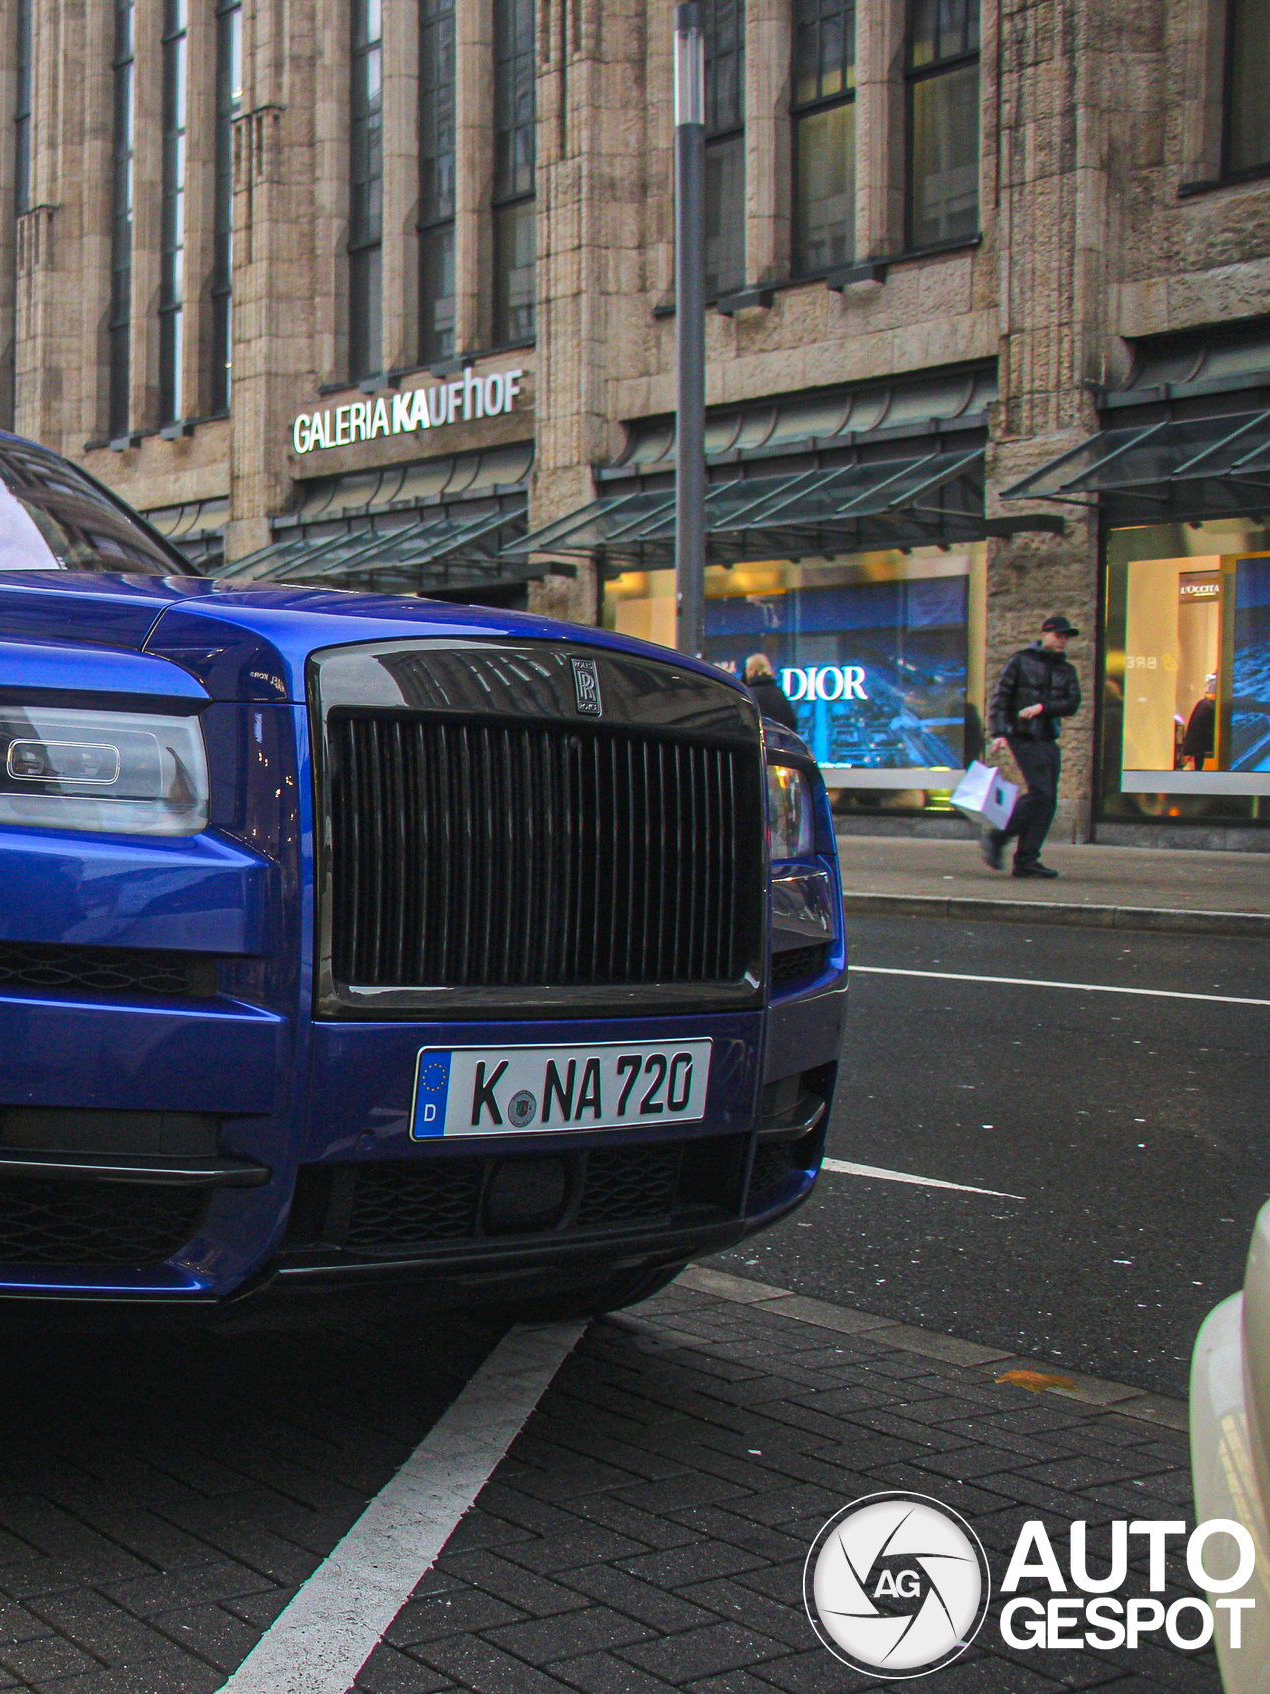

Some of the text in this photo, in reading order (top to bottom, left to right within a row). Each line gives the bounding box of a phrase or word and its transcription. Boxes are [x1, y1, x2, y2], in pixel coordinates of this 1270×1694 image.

[293, 397, 390, 454] GALERIA
[779, 665, 869, 701] DIOR
[470, 1059, 510, 1126] K
[541, 1056, 602, 1123] NA
[616, 1051, 694, 1117] 720
[423, 1103, 438, 1122] D
